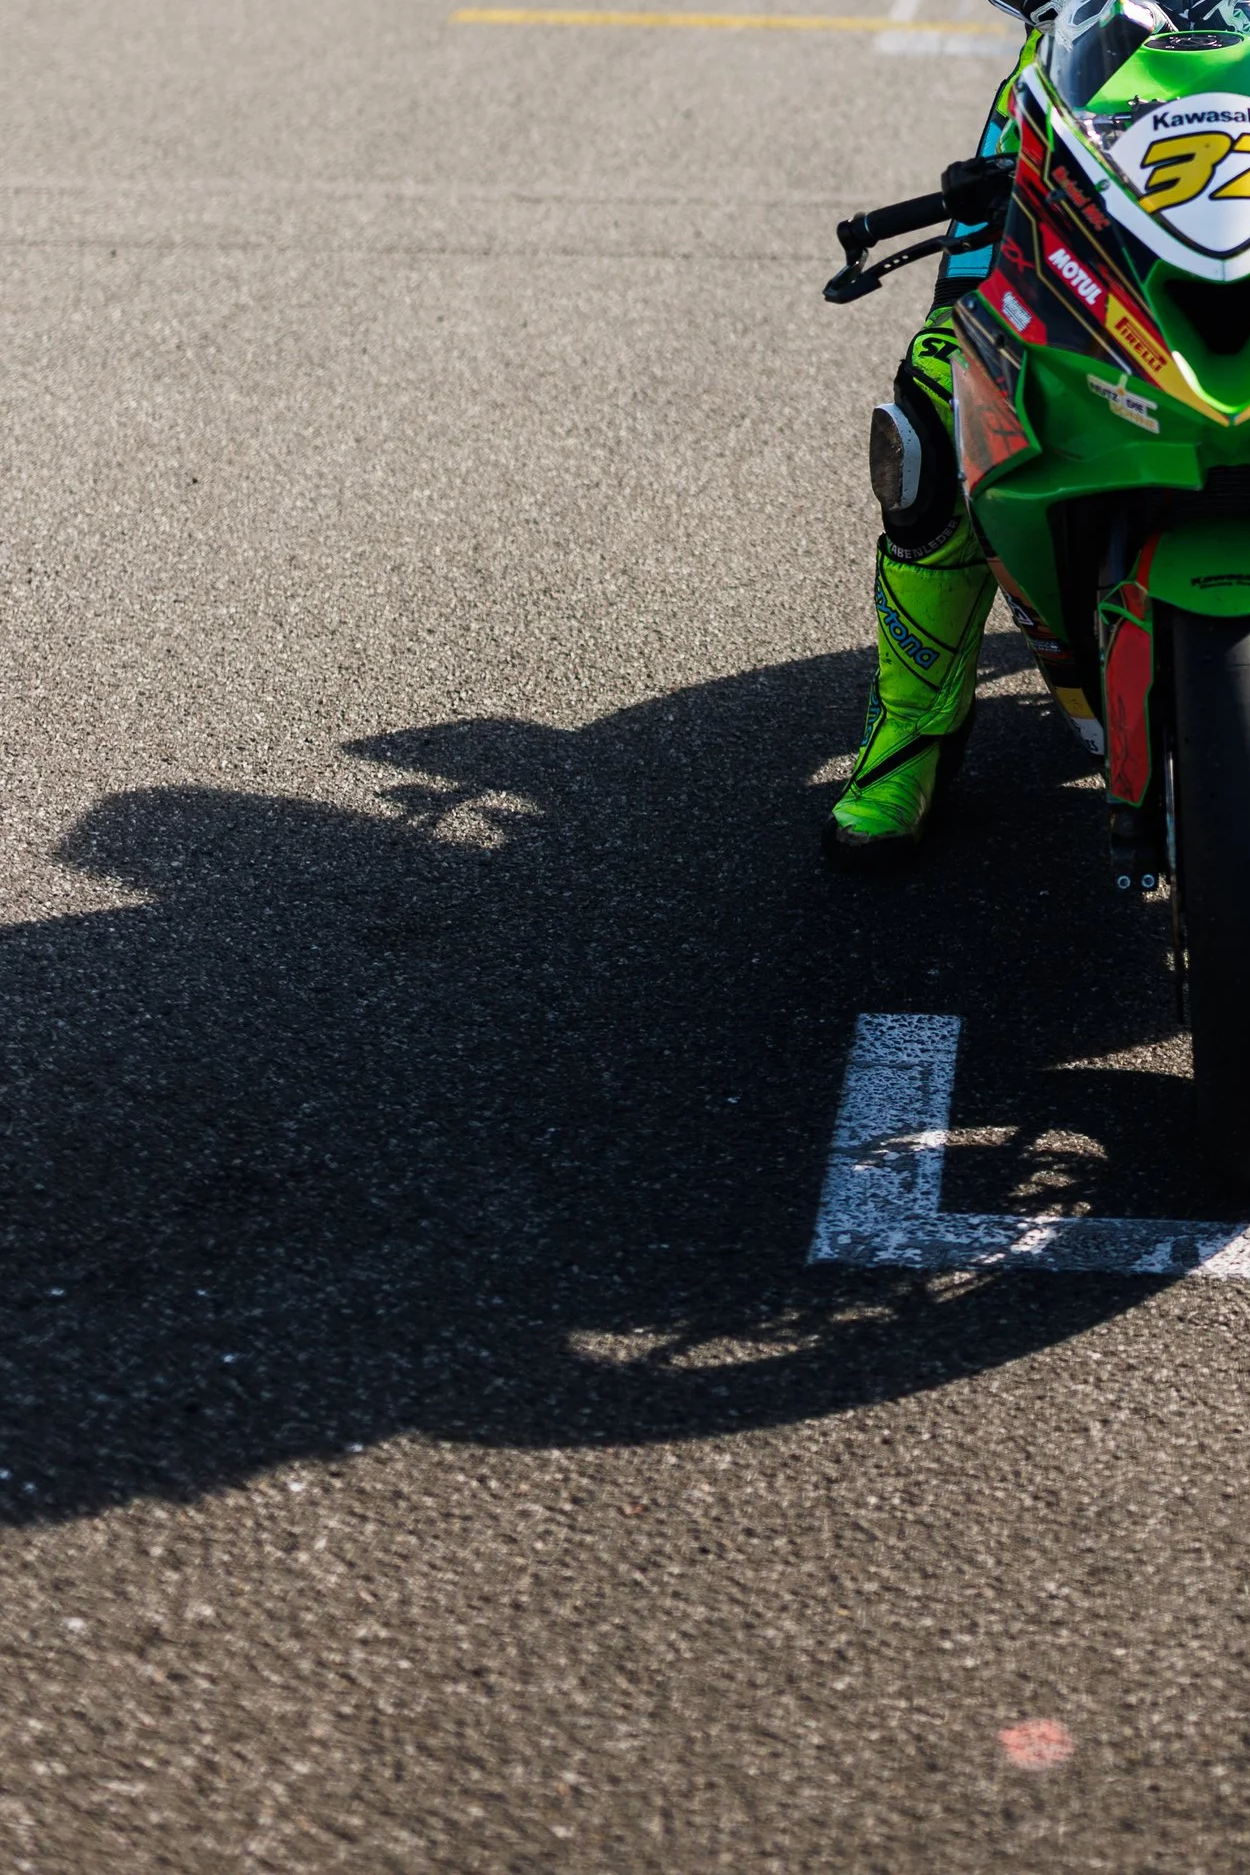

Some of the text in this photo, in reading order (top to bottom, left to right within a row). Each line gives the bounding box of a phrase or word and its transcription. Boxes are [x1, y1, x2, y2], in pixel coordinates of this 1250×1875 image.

[1048, 248, 1103, 306] MOTUL
[1114, 316, 1168, 374] PIRELLI
[887, 518, 959, 560] ABENLEDER
